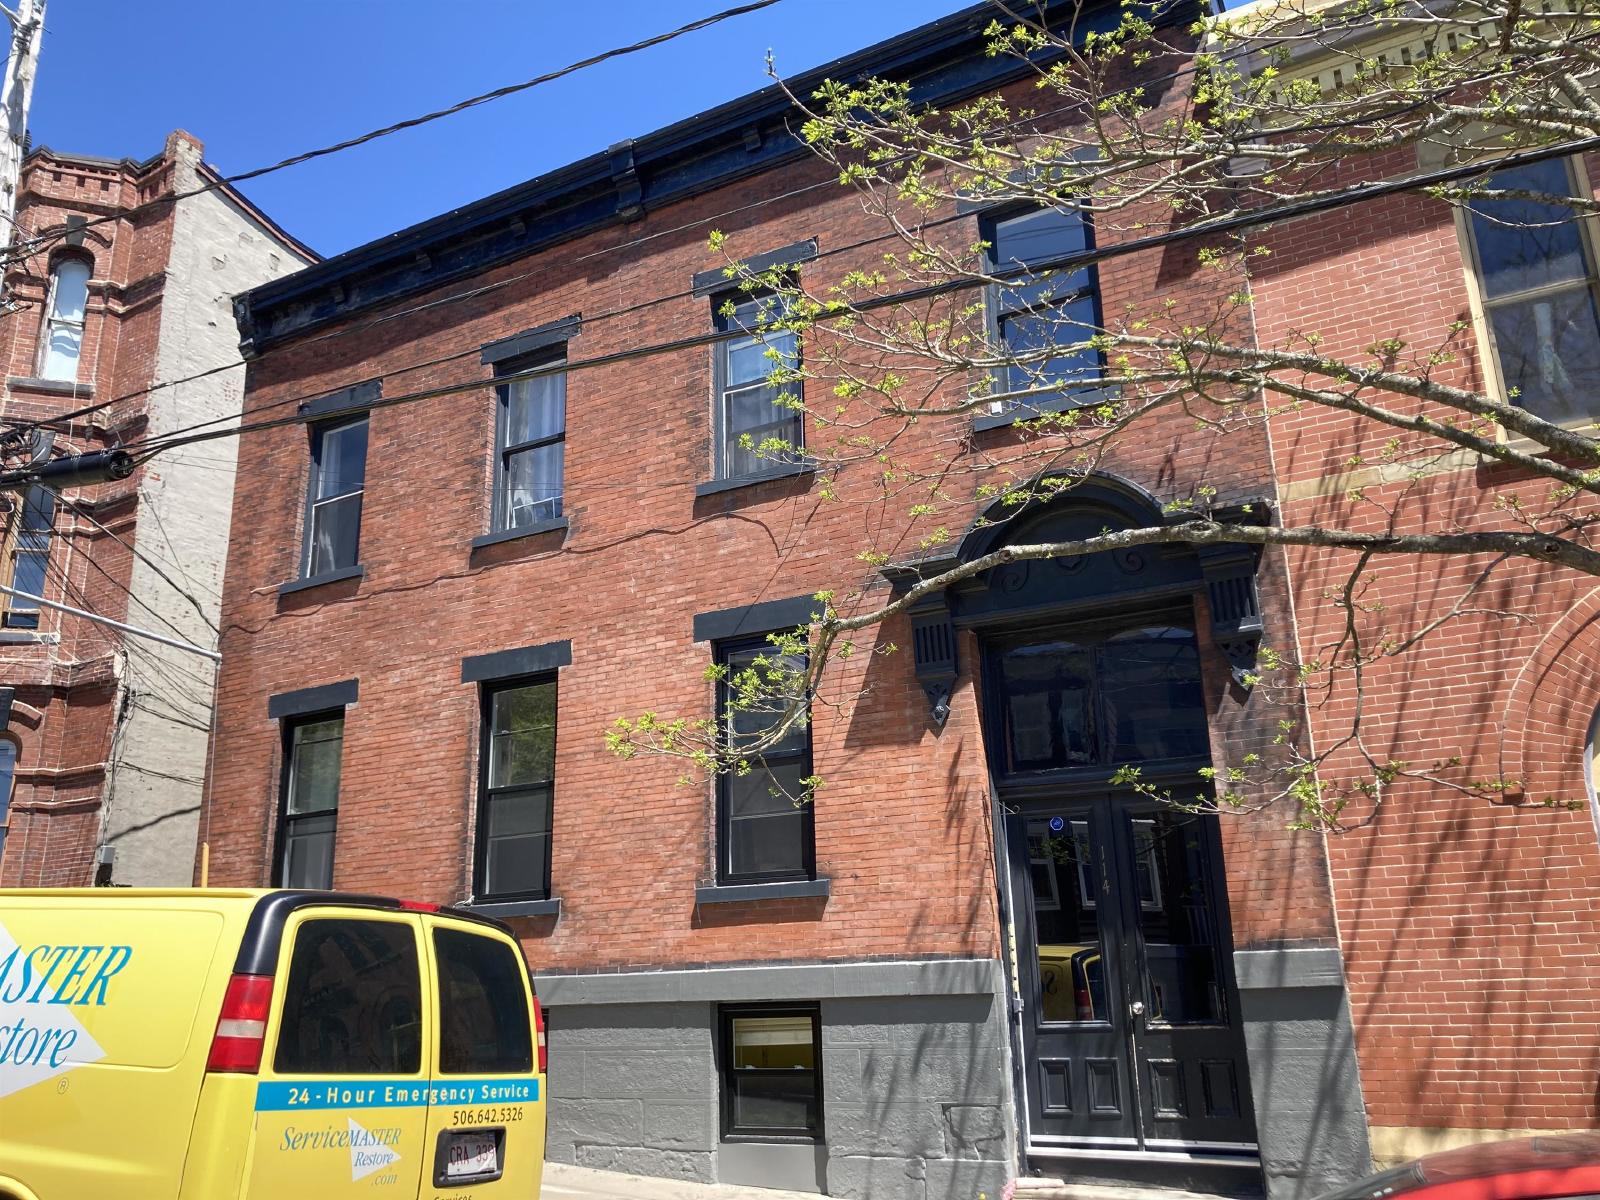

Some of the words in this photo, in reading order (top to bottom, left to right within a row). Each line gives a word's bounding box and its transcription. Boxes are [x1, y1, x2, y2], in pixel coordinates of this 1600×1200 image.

[384, 1085, 476, 1105] Emergency
[481, 1083, 530, 1100] Service
[452, 1106, 524, 1126] 506.642.5326
[354, 1151, 394, 1168] Restore
[449, 1145, 470, 1166] CRA
[370, 1173, 398, 1187] .com
